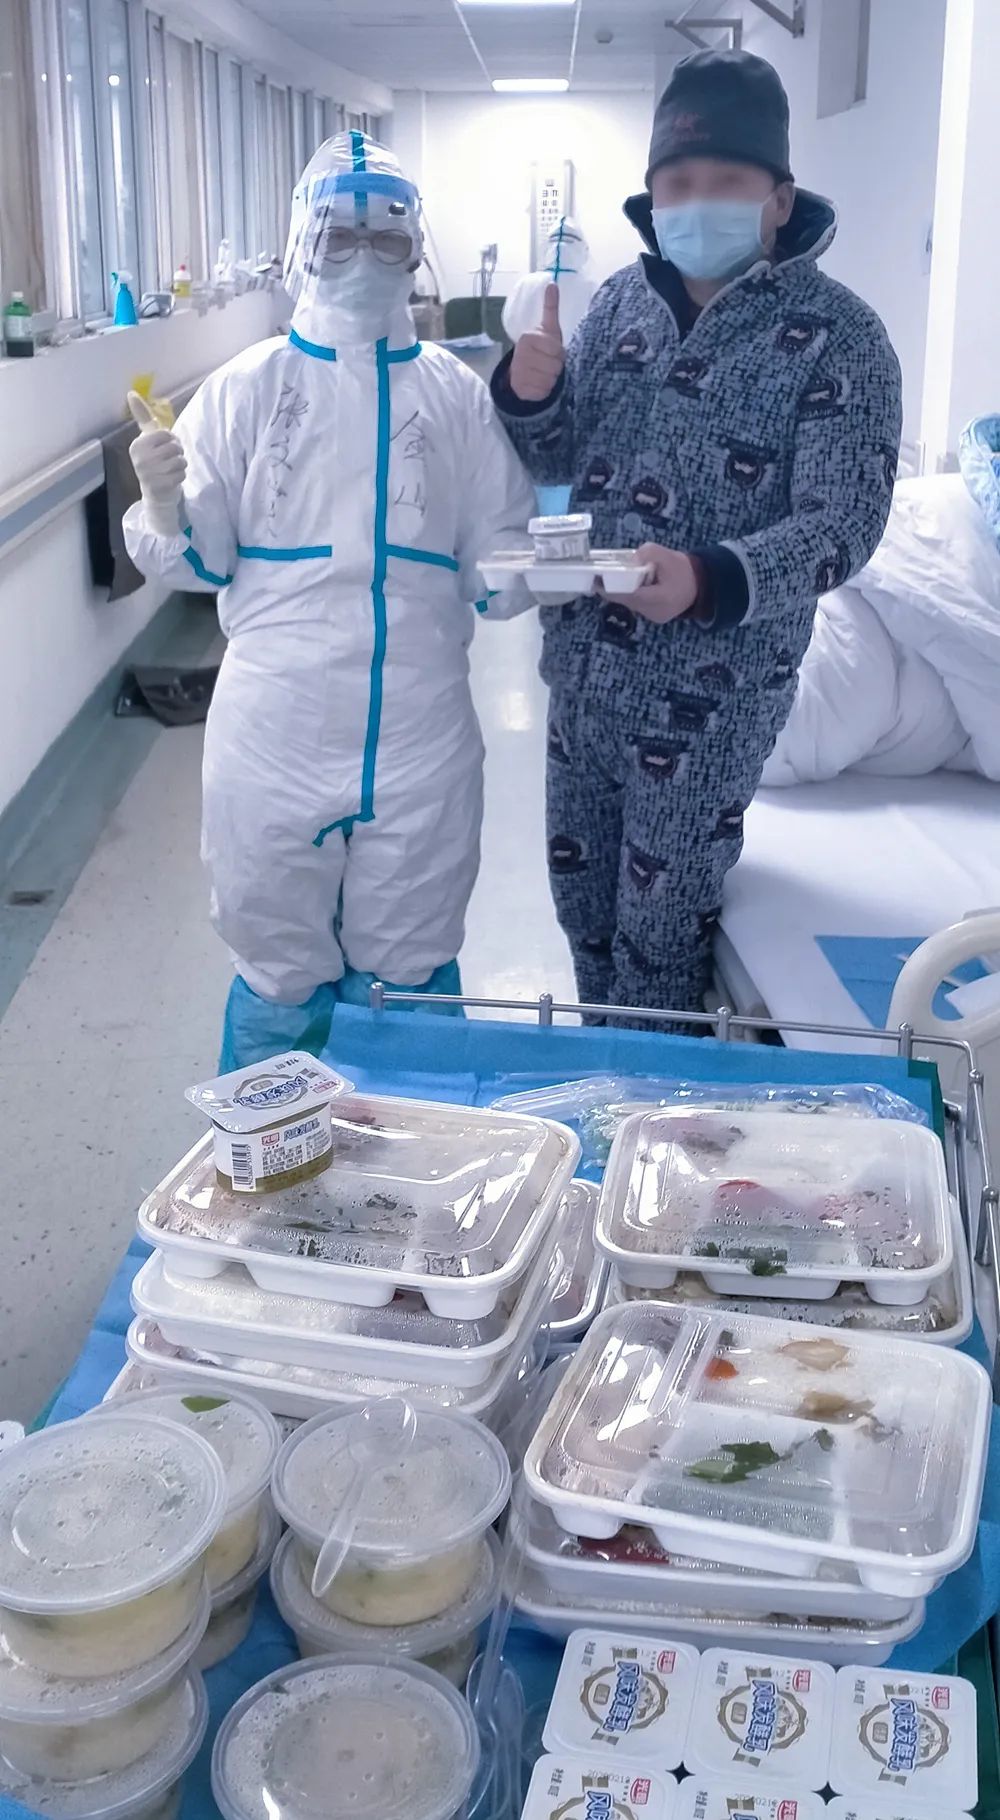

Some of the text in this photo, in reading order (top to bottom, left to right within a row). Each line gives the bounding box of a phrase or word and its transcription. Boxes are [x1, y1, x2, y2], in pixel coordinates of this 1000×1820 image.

[602, 1660, 640, 1732] 风味发酵乳
[743, 1679, 777, 1752] 风味发酵乳
[887, 1698, 918, 1772] 风味发酵乳
